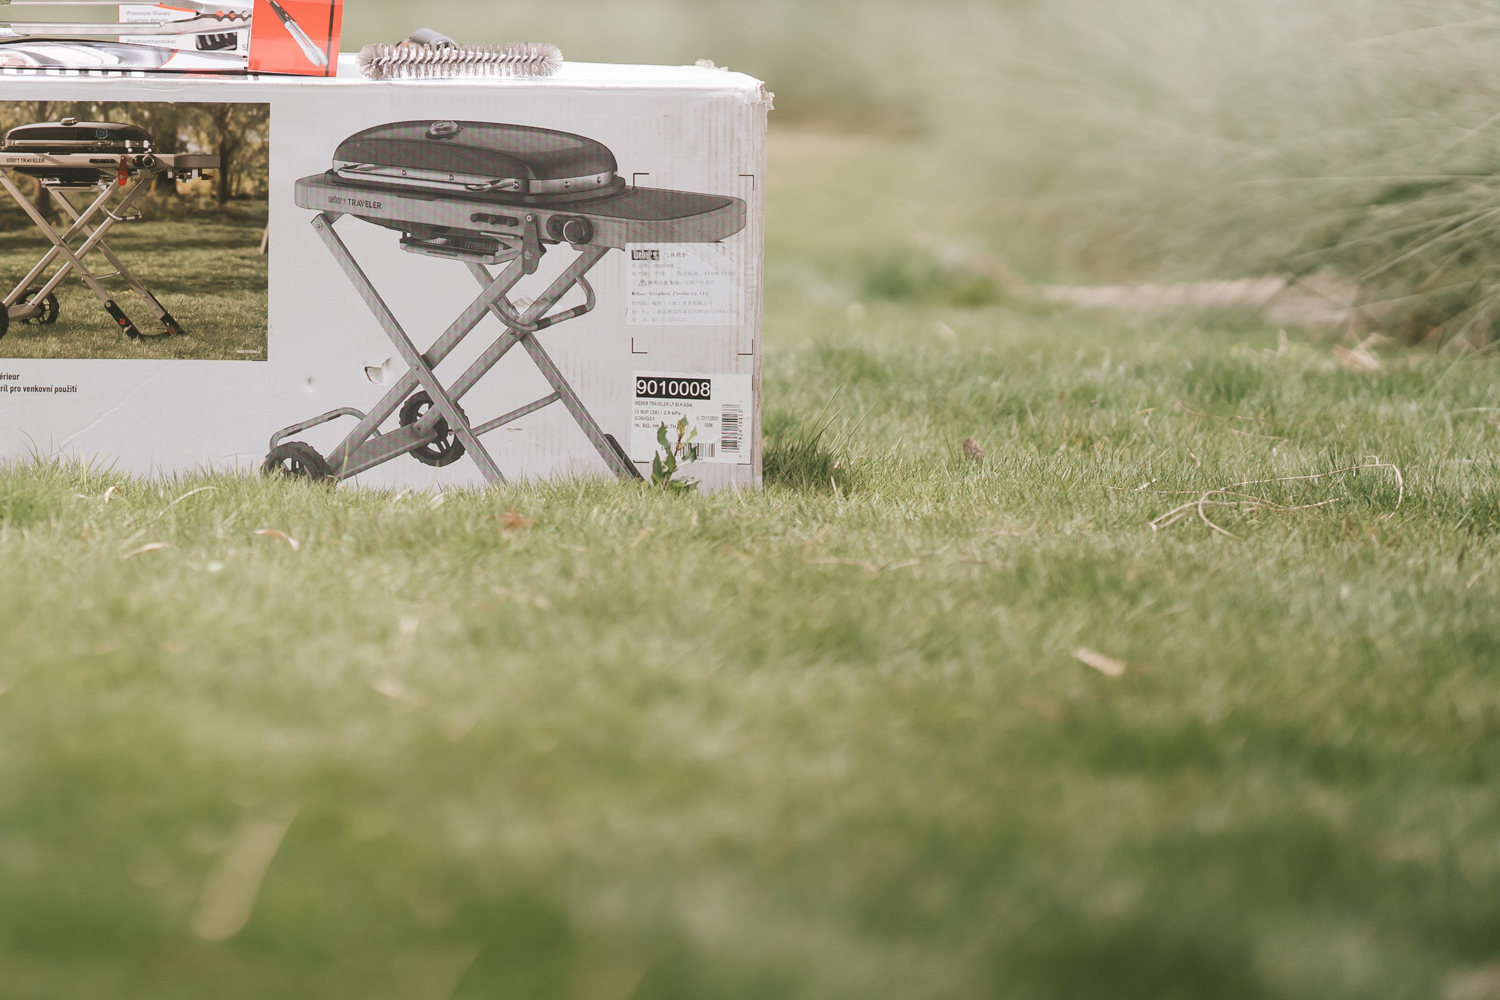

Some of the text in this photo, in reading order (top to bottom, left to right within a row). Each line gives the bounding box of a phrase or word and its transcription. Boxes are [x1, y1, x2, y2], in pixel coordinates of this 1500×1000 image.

[348, 198, 382, 210] TRAVELER
[22, 384, 53, 393] venkovní
[54, 384, 78, 394] použití
[636, 380, 710, 397] 9010008
